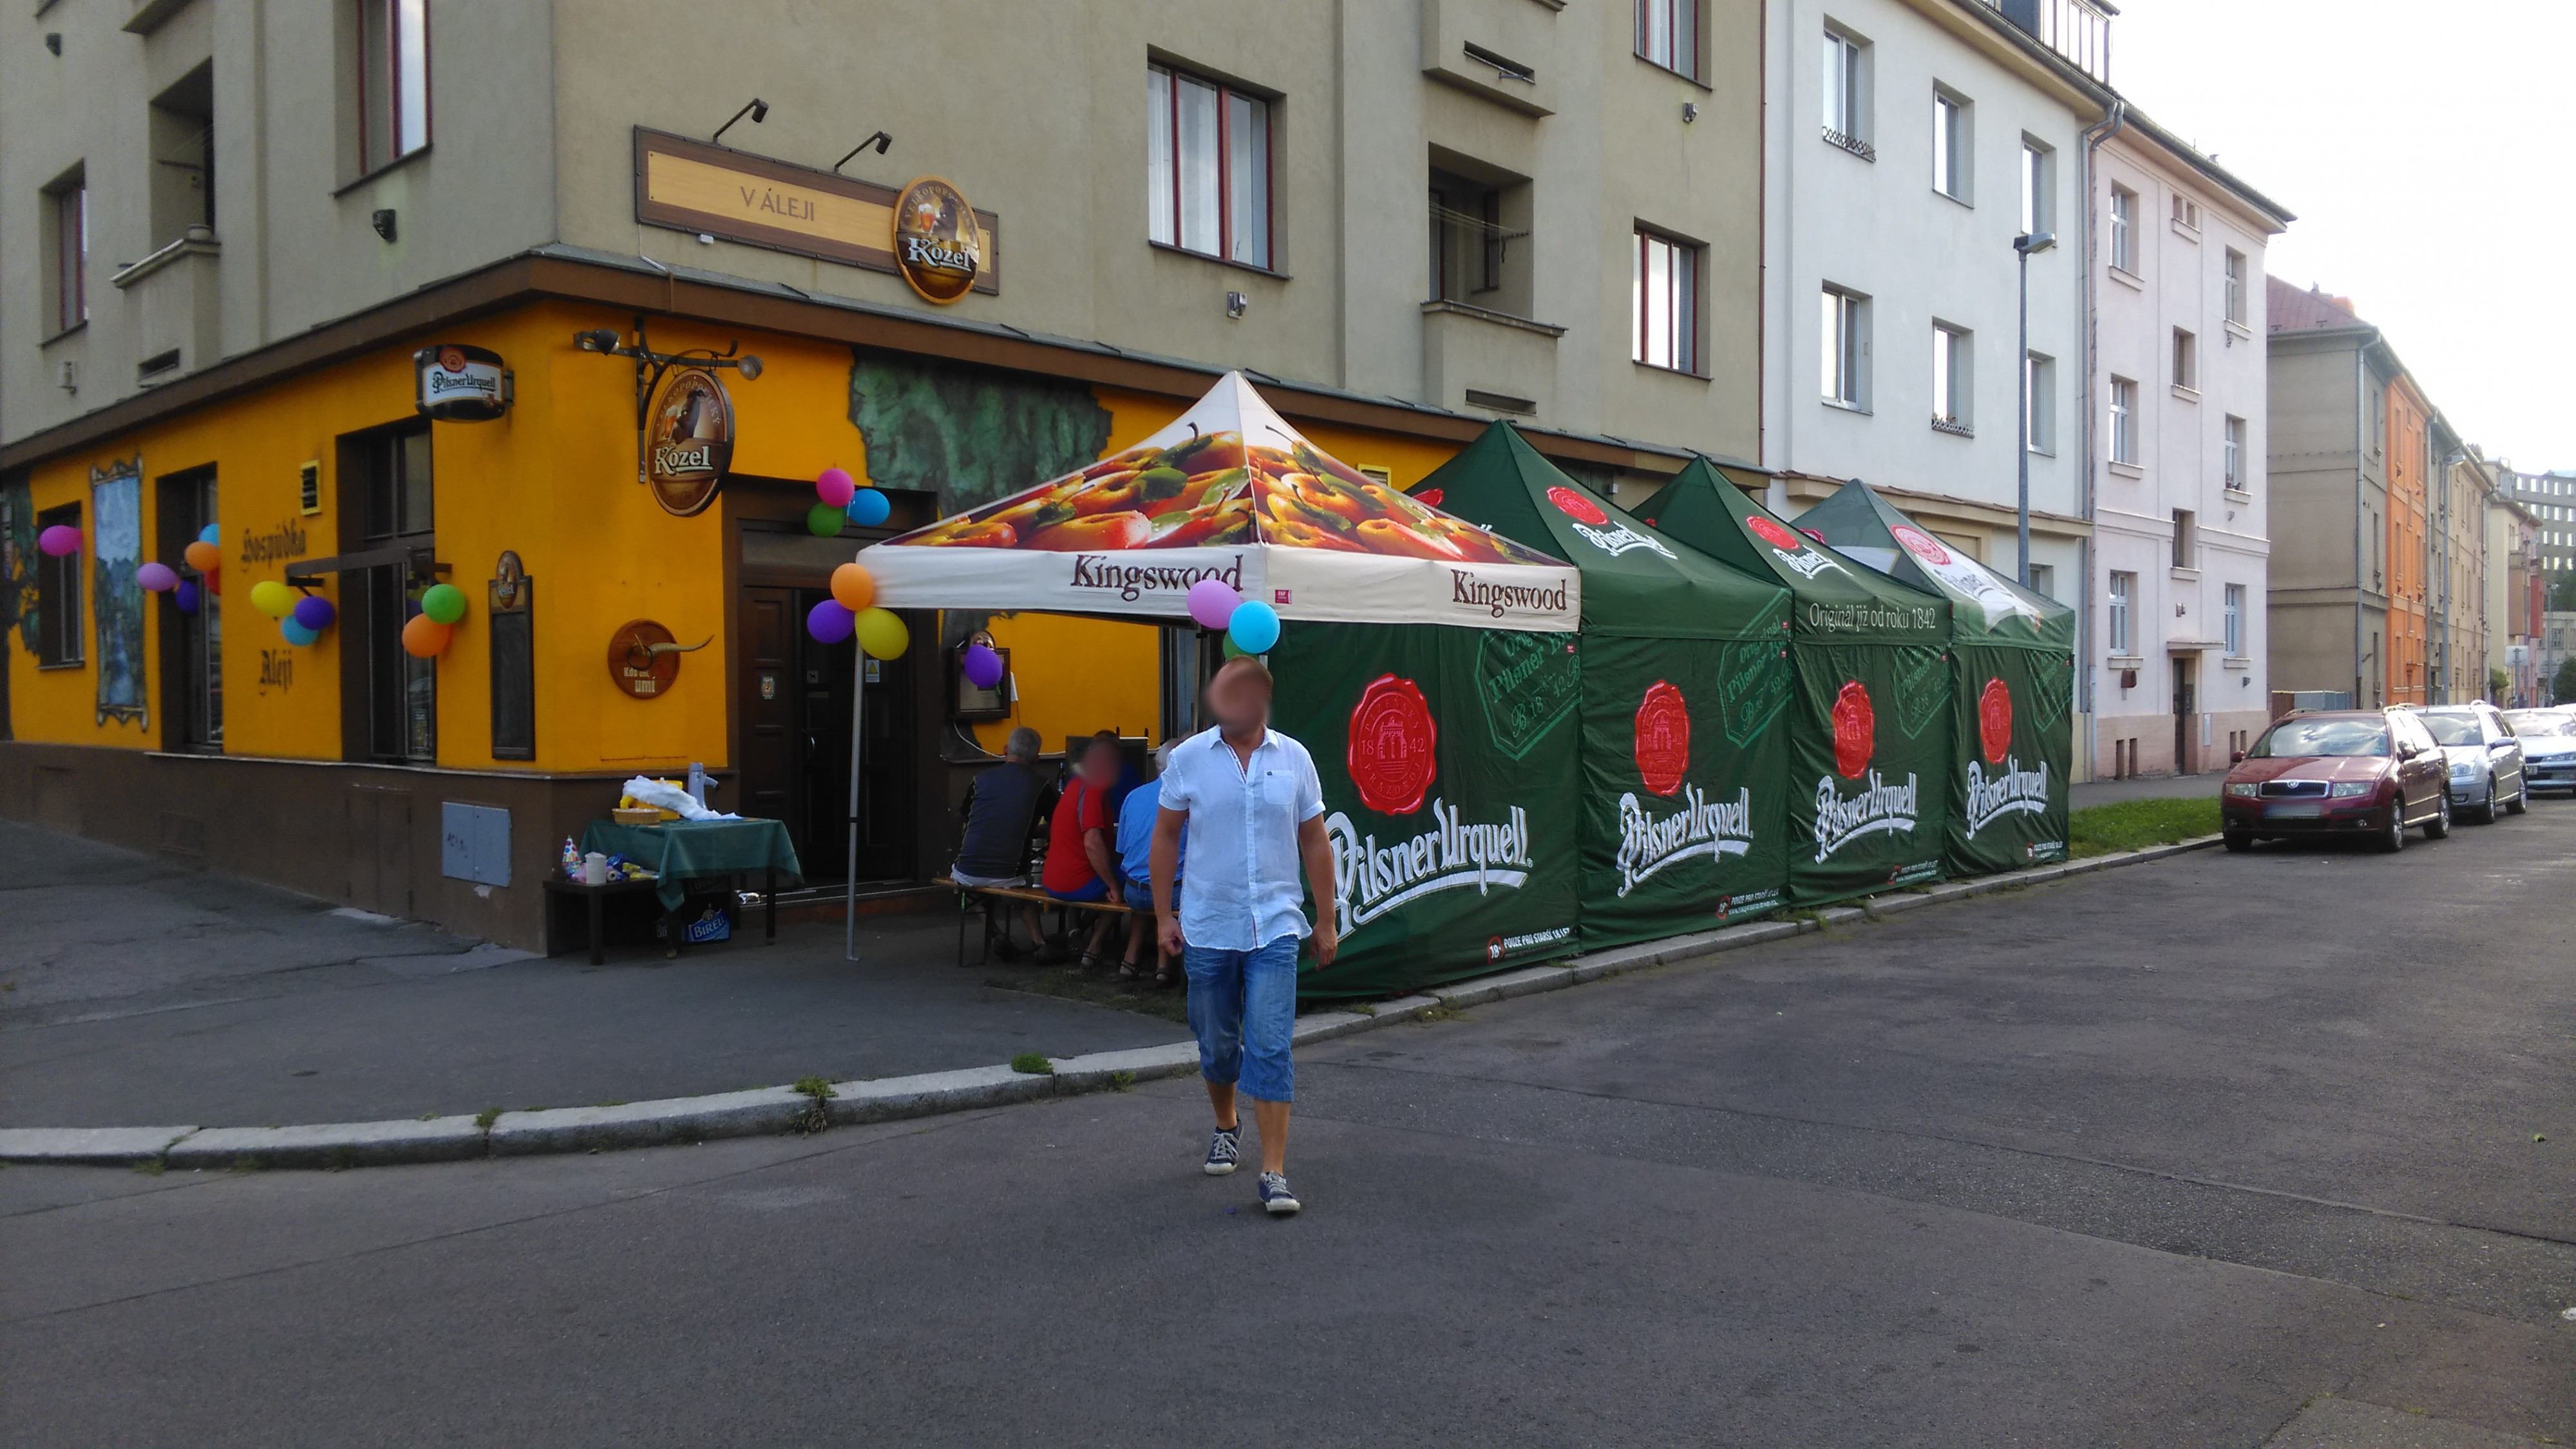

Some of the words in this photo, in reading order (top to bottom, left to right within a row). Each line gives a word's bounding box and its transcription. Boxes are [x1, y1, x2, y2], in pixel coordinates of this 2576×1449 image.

[740, 186, 755, 207] V
[760, 187, 814, 222] ÁLEJI
[907, 236, 972, 272] Kozel
[432, 370, 467, 394] Pilsner
[466, 373, 497, 391] Urquell
[654, 445, 714, 475] Kozel
[1450, 568, 1567, 618] Kingswood
[1809, 602, 1853, 632] Originál
[1870, 605, 1884, 627] od
[1886, 606, 1909, 629] roku
[1911, 607, 1936, 629] 1842
[1361, 740, 1374, 755] 18
[1409, 737, 1425, 753] 42
[1966, 760, 2010, 840] Pilsner
[2008, 753, 2047, 817] Urquell
[1815, 775, 1871, 865] Pilsner
[1869, 766, 1917, 837] Urquell
[1433, 796, 1528, 897] Urquell
[1615, 791, 1690, 898] Pilsner
[1685, 782, 1750, 863] Urquell
[1503, 936, 1522, 949] POUZE
[1522, 934, 1534, 945] PRO
[1552, 929, 1561, 940] 18
